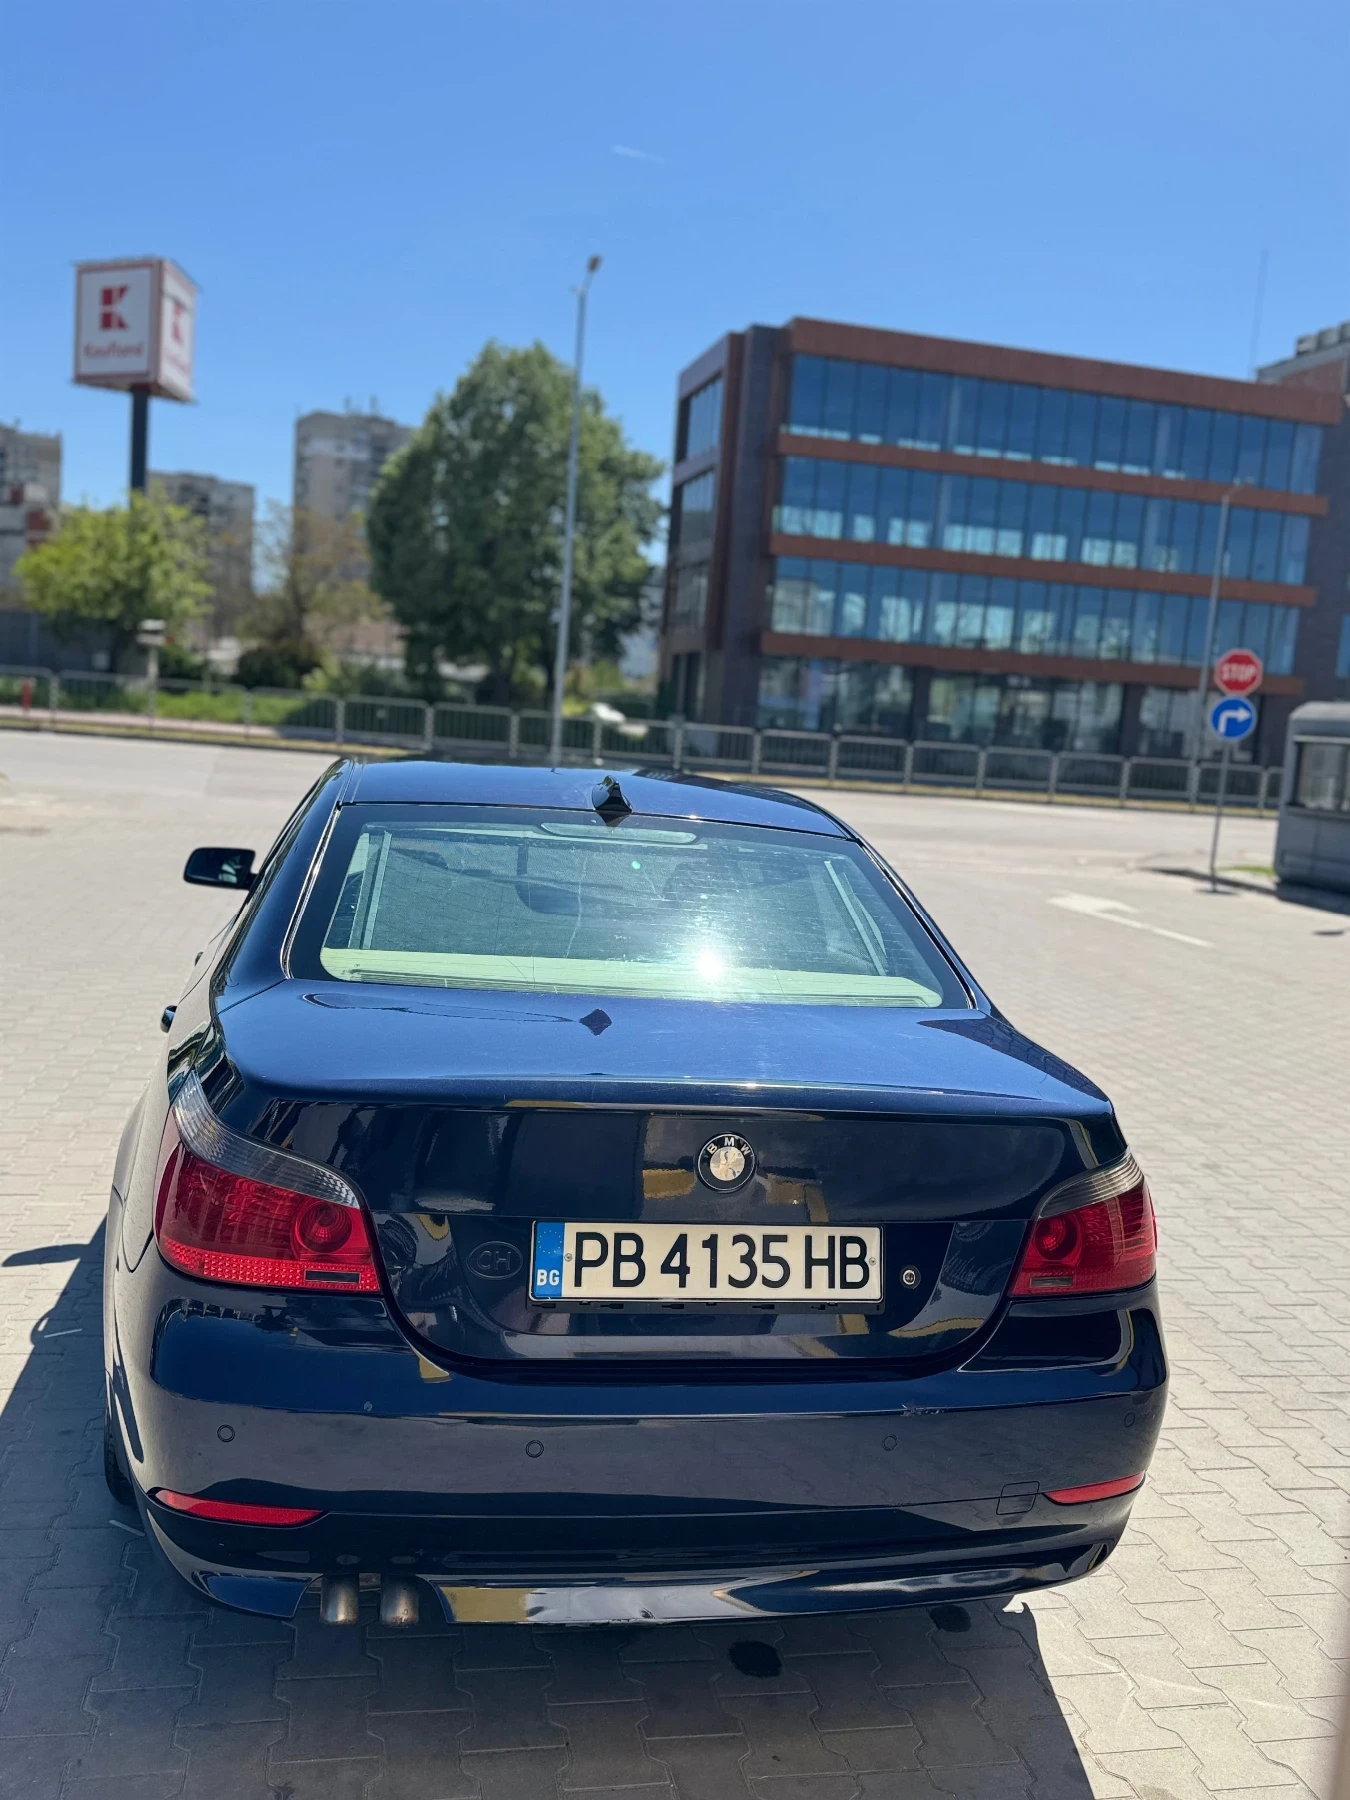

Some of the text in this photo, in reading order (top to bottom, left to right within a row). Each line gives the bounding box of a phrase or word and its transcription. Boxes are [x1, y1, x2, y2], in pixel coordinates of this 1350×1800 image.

[101, 285, 129, 330] K
[1222, 663, 1256, 682] STOP
[706, 1136, 751, 1155] BMW
[573, 1231, 870, 1290] PB 4135 HB
[536, 1269, 560, 1287] BG
